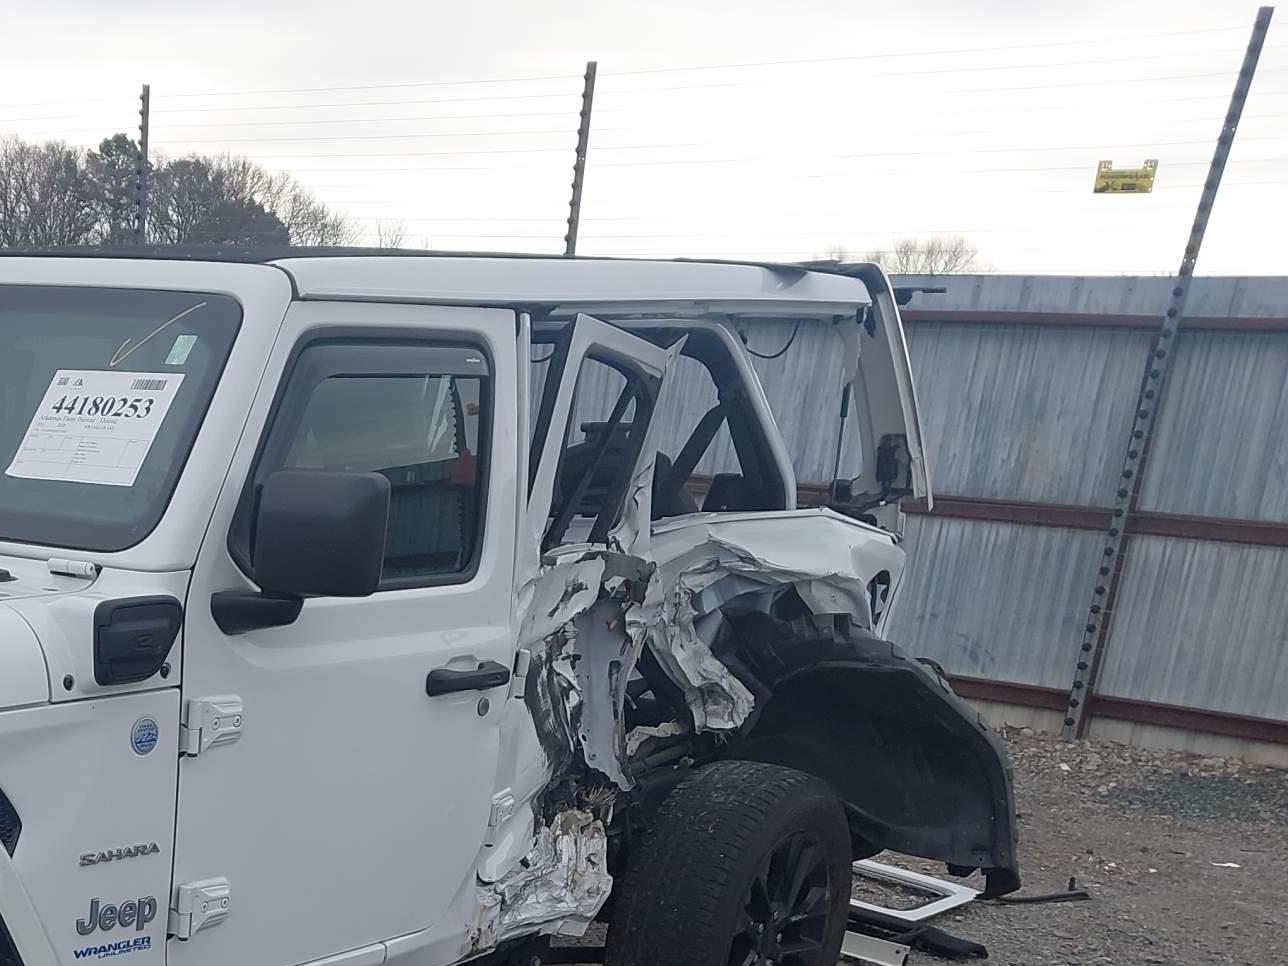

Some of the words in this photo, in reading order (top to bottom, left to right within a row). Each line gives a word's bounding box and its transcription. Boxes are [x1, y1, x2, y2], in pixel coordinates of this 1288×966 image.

[51, 395, 154, 419] 44180253
[79, 842, 160, 867] SAHARA
[76, 895, 158, 936] Jeep
[73, 936, 152, 960] WRANGLER
[97, 944, 152, 960] UNLIMITED
